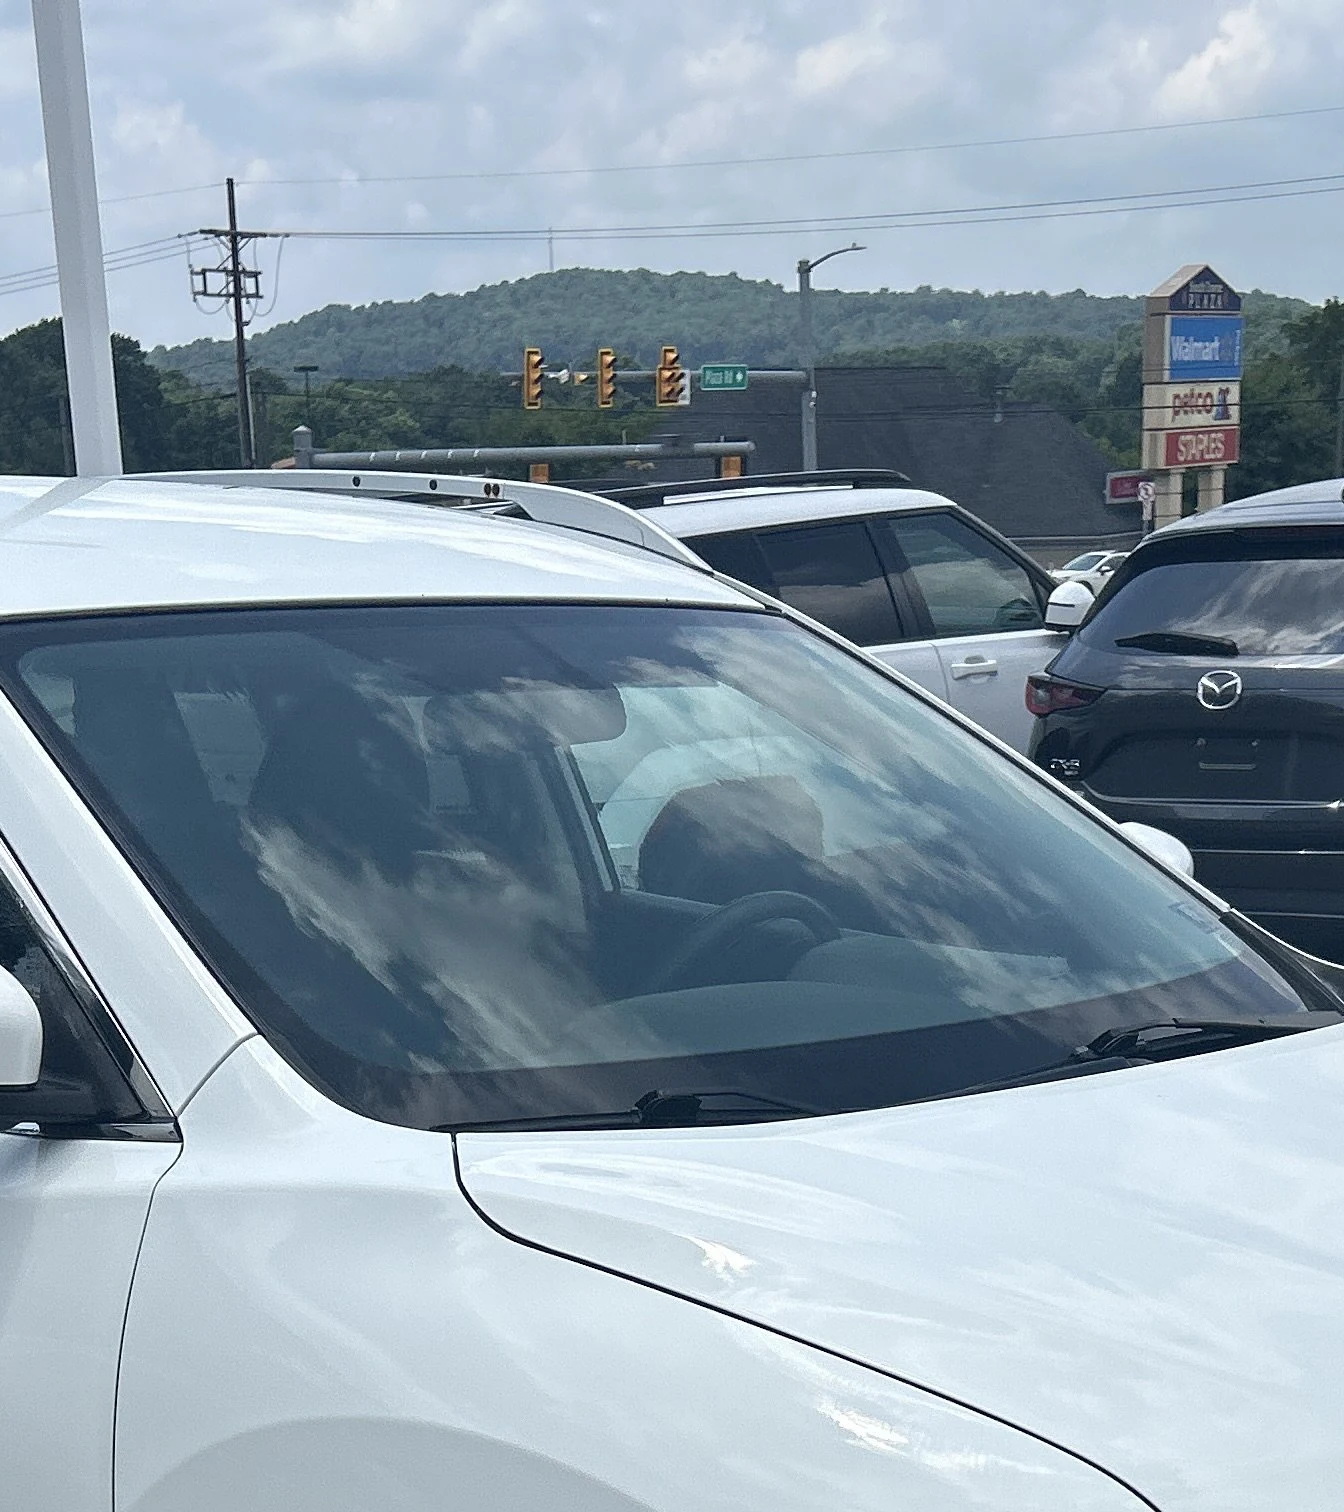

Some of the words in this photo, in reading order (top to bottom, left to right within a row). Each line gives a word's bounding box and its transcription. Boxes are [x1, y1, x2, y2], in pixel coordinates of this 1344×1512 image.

[1171, 335, 1220, 361] Walmart
[1172, 388, 1213, 423] petco
[1177, 433, 1225, 461] STAPLES
